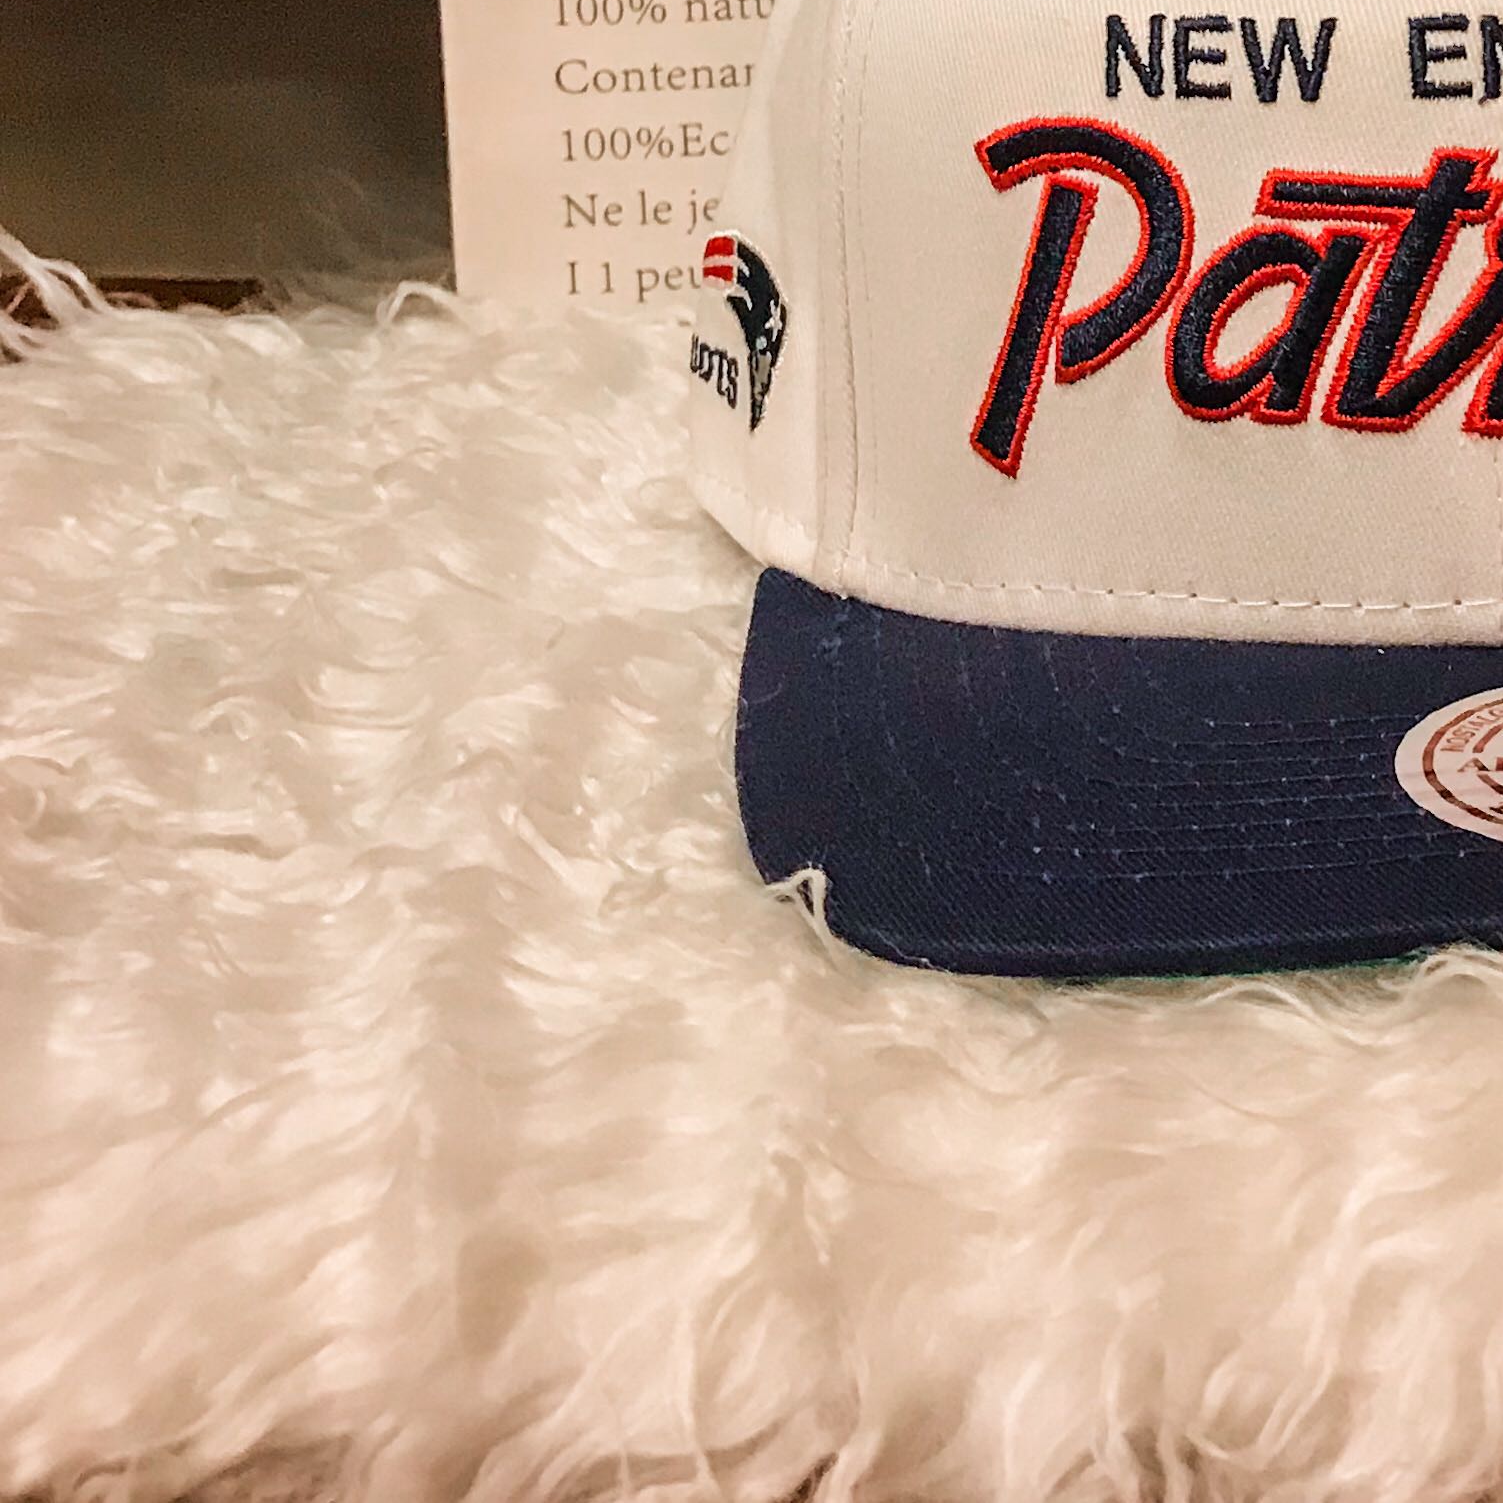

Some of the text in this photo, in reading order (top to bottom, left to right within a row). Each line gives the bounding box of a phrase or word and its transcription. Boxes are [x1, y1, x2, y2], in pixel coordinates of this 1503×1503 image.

[1105, 14, 1338, 102] NEW
[560, 193, 624, 229] Ne
[638, 189, 673, 226] le
